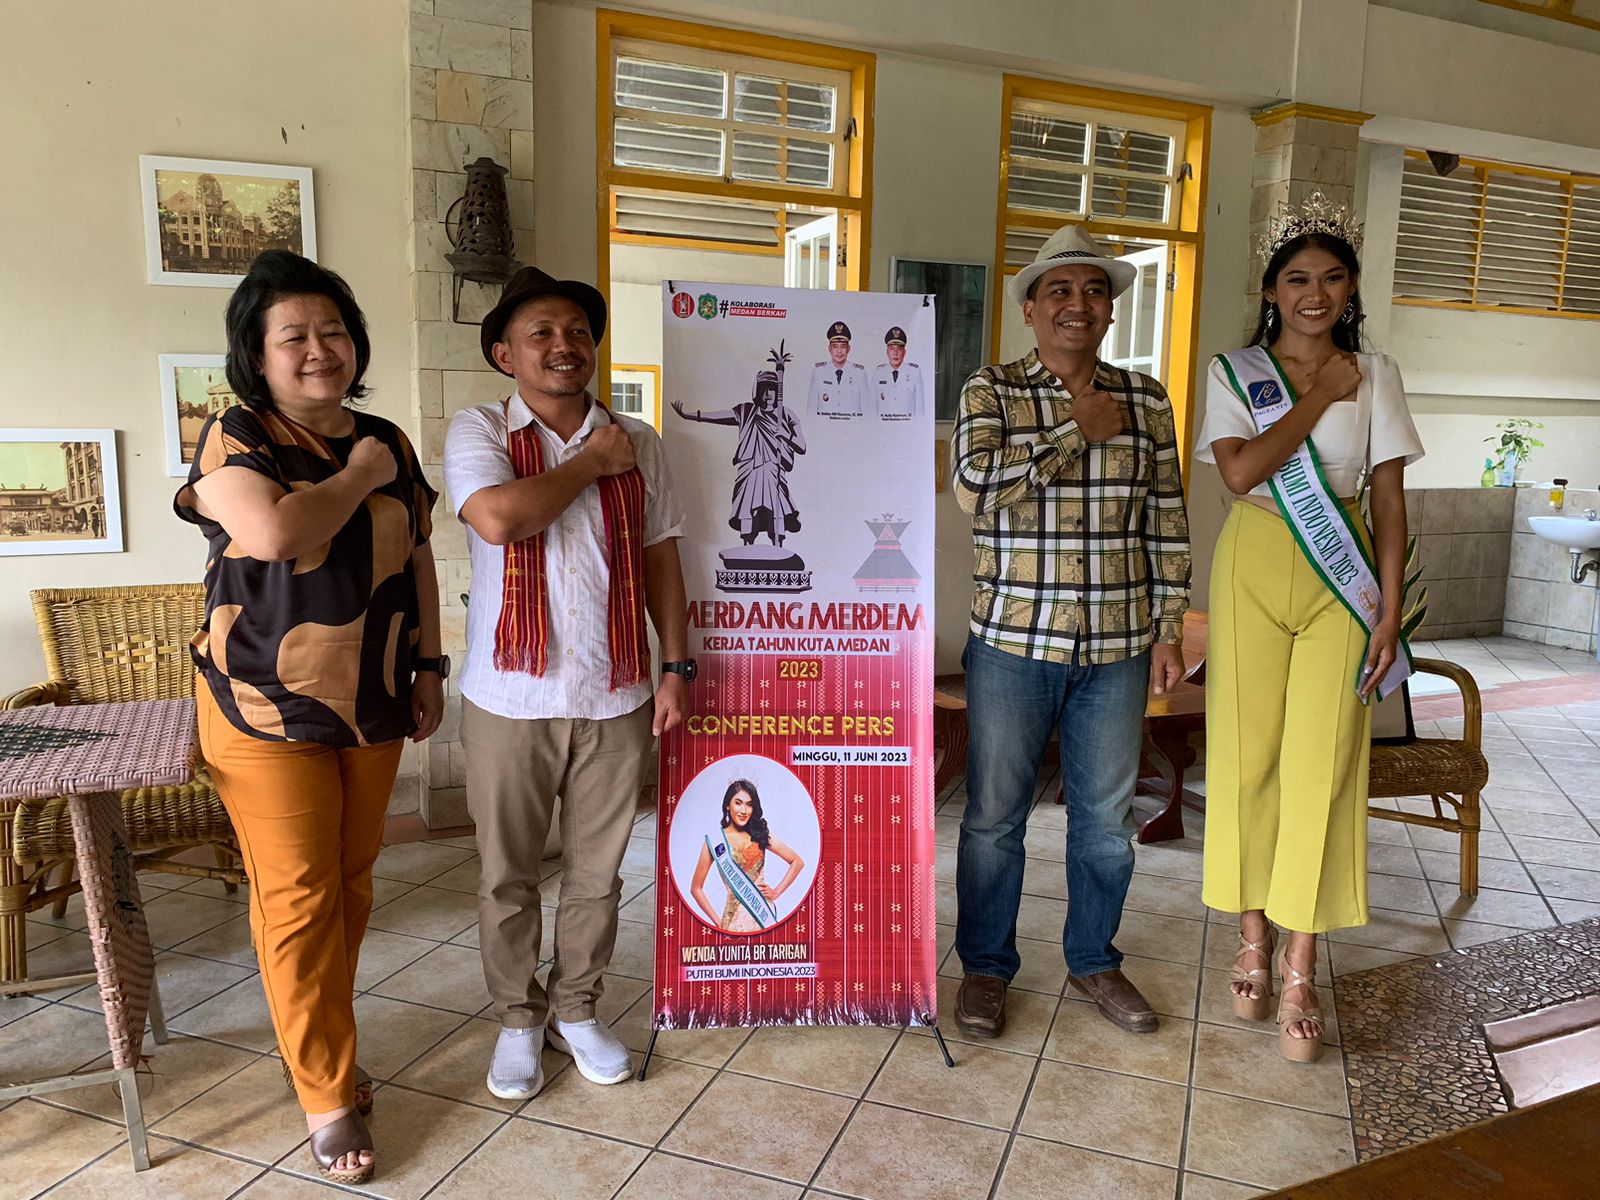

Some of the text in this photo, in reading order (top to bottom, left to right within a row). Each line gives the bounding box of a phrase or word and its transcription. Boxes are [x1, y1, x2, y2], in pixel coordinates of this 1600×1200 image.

[1253, 402, 1288, 417] PAGEANTS
[1278, 457, 1359, 587] BUMI INDONESIA 2023
[808, 602, 926, 631] MERDEM
[703, 636, 890, 652] KERJA TAHUN KUTA MEDAN
[779, 661, 819, 679] 2023
[687, 715, 895, 736] CONFERENCE PERS
[793, 751, 908, 763] MINGGU, 11 JUNI 2023
[682, 944, 807, 963] WENDA YUNITA BR TARIGAN
[686, 966, 815, 979] PUTRI BUMI INDONESIA 2023
